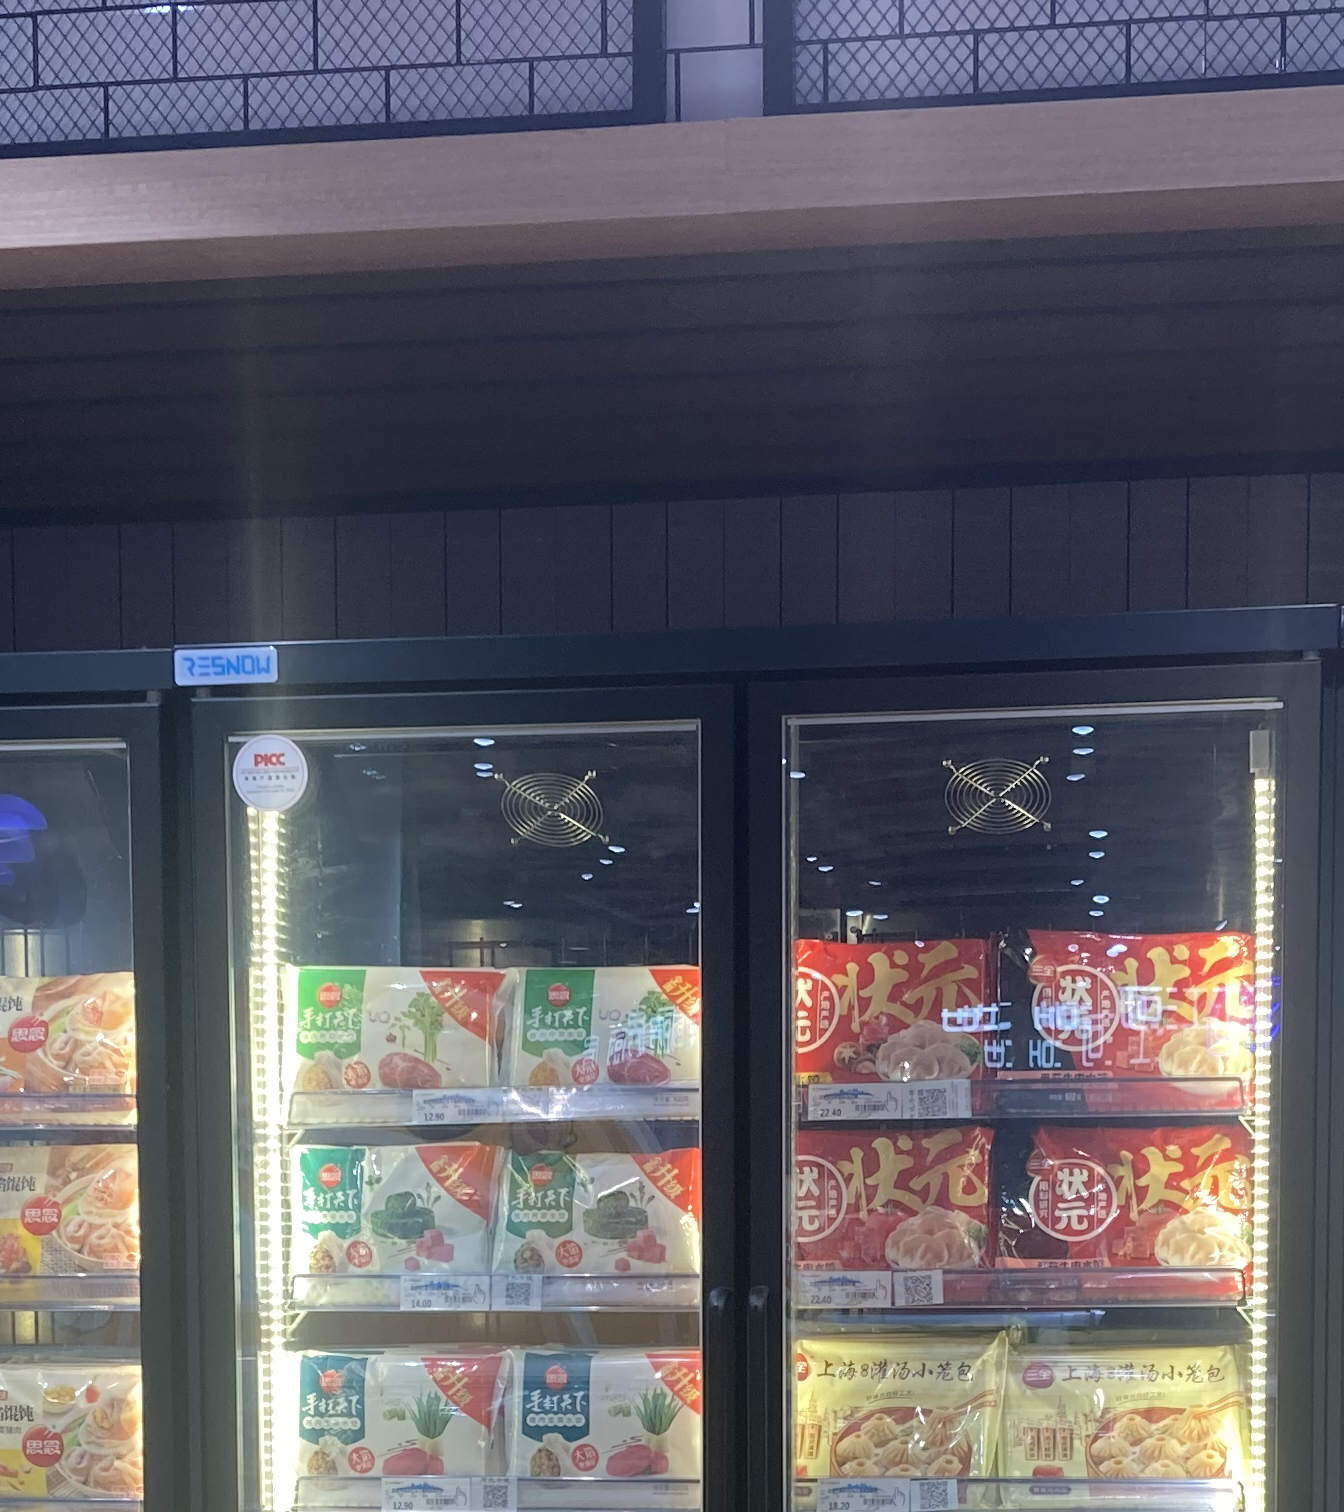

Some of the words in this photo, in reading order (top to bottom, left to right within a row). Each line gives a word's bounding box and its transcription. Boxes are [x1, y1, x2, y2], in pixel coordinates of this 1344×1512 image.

[182, 655, 270, 677] RESNOW
[253, 753, 285, 767] PICC
[836, 941, 980, 1034] 状元
[1117, 936, 1255, 1022] 状元
[840, 1129, 987, 1222] 状元
[1109, 1134, 1252, 1221] 状元
[25, 1207, 58, 1223] 思念
[1058, 1167, 1091, 1231] 状元
[1025, 1370, 1052, 1383] 三全
[27, 1439, 61, 1456] 思念
